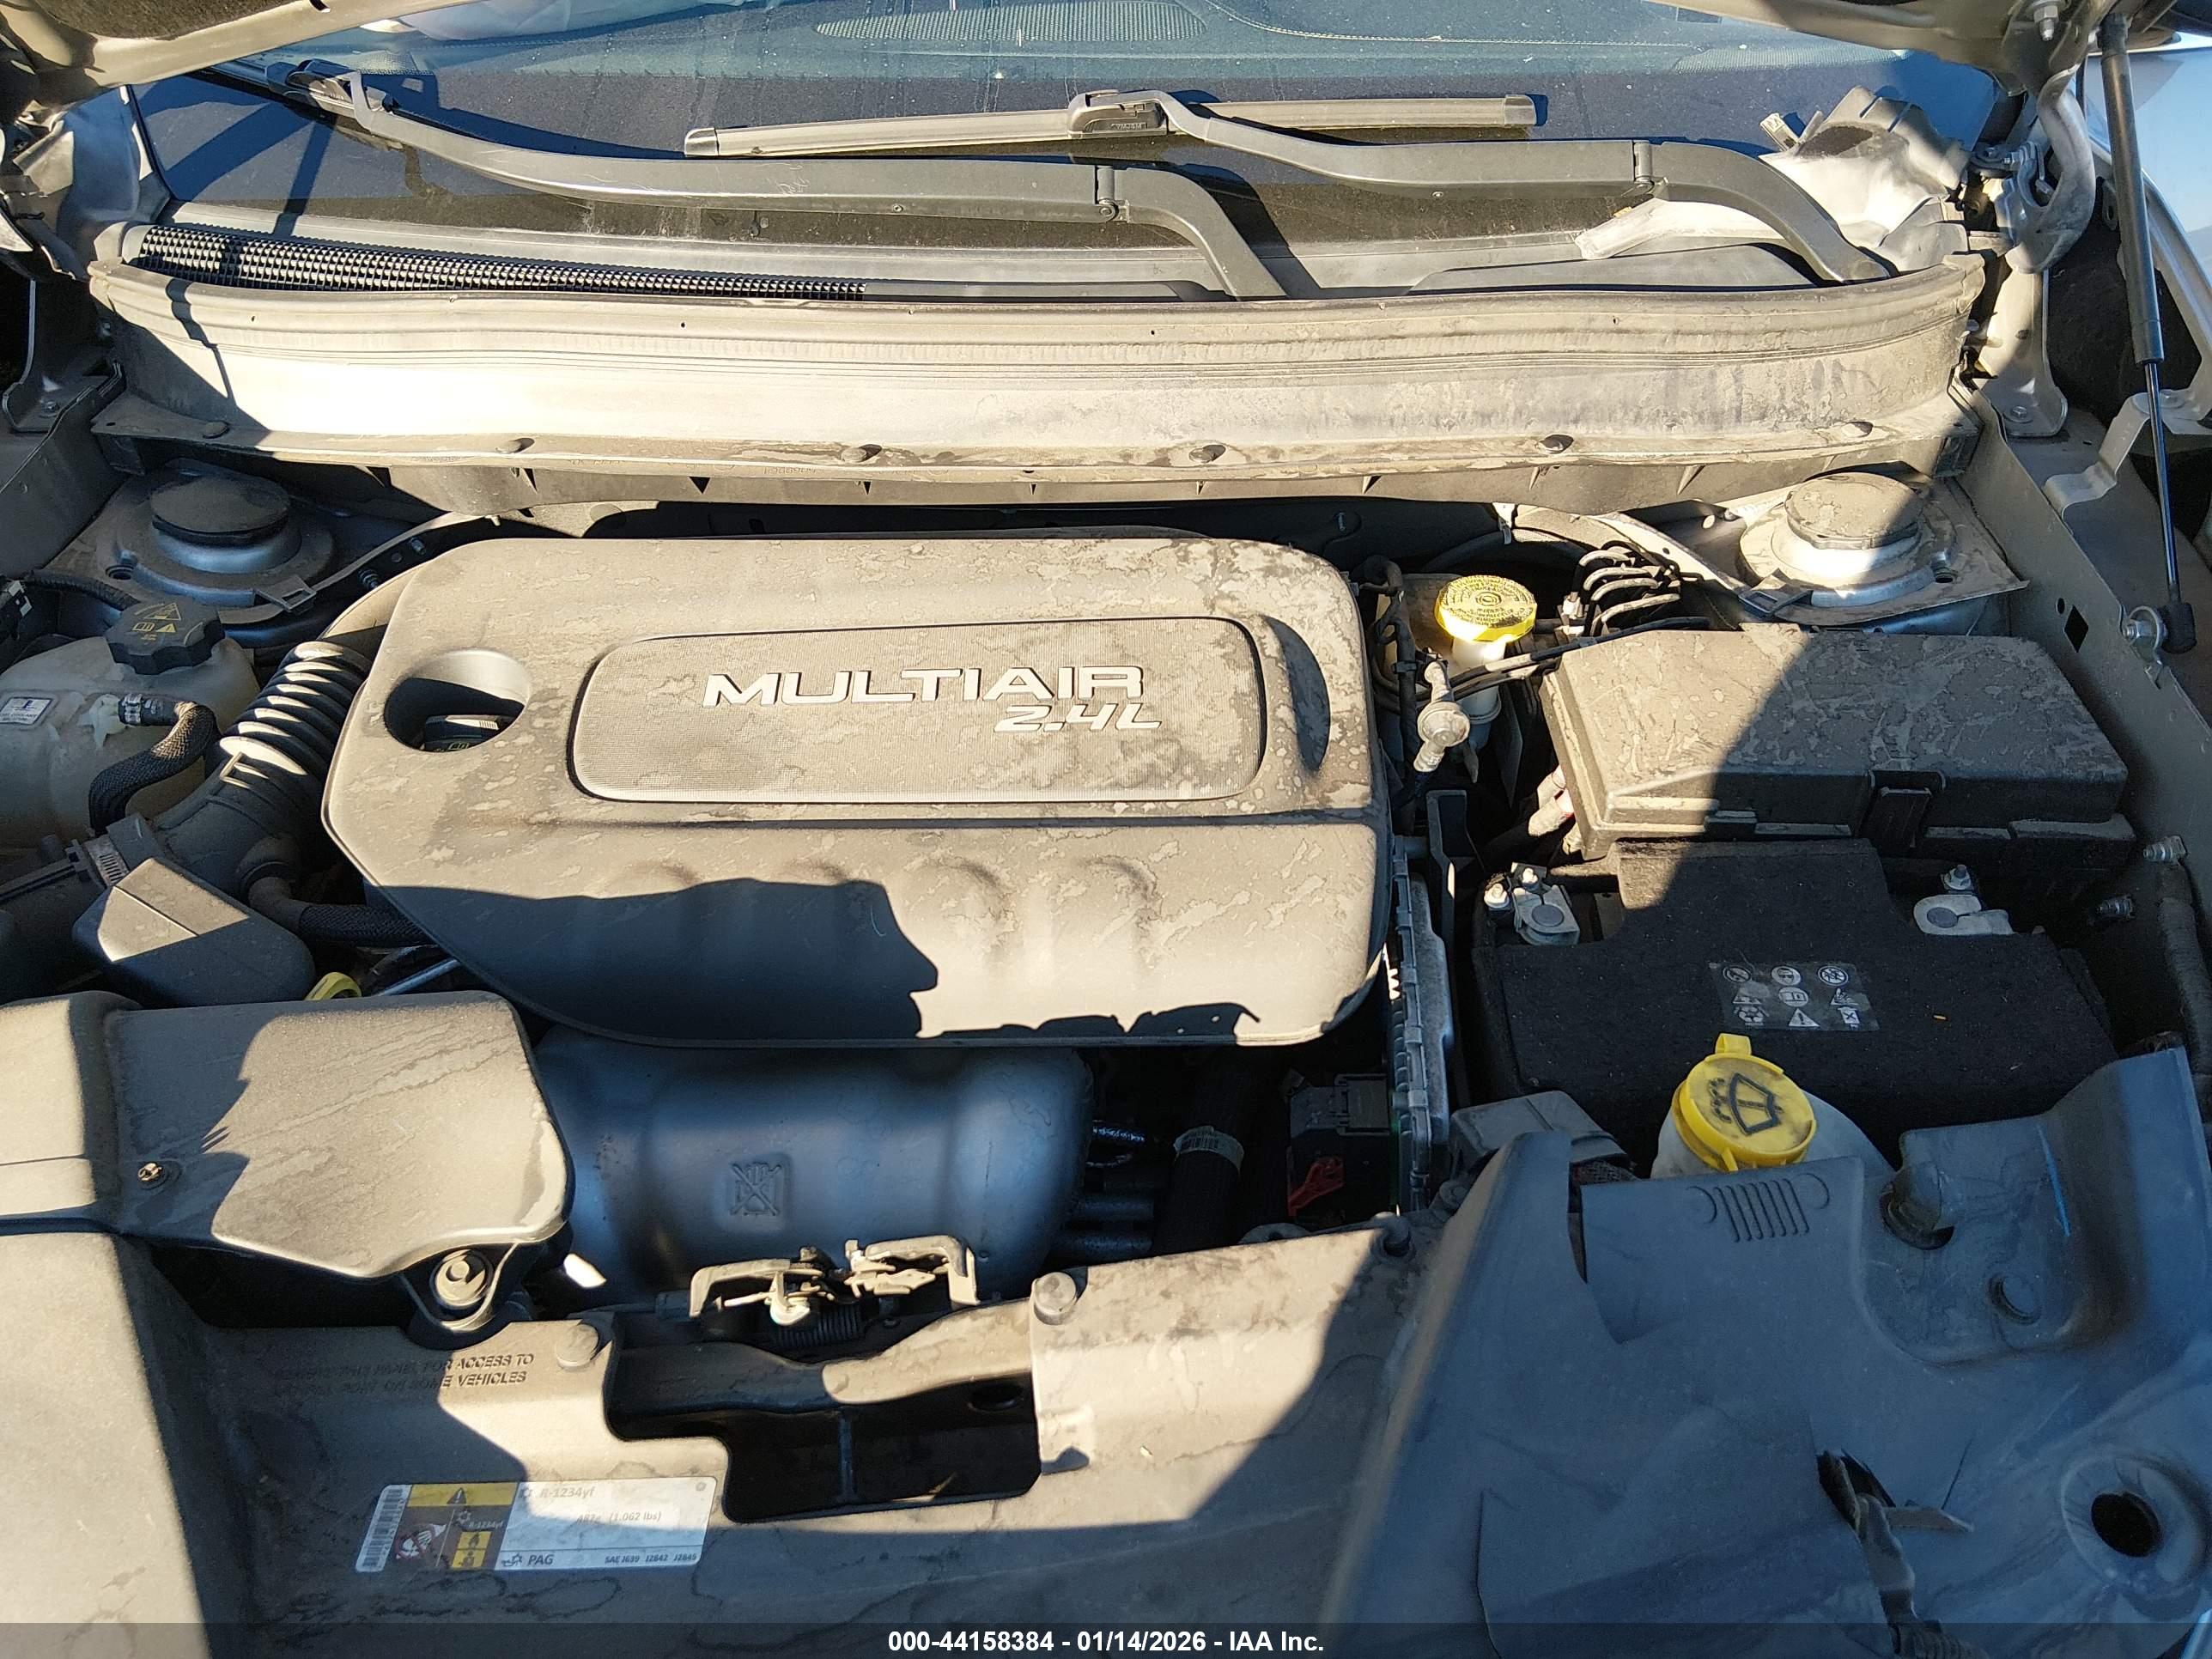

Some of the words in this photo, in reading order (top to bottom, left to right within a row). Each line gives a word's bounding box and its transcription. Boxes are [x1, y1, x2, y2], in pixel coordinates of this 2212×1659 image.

[702, 665, 1143, 708] MULTIAIR
[994, 702, 1162, 733] 2.4L
[455, 1354, 511, 1370] ACCESS
[515, 1353, 534, 1365] TO
[457, 1371, 527, 1387] VEHICLES
[539, 1486, 595, 1500] R-1234yf
[609, 1511, 640, 1523] (1.062
[643, 1511, 661, 1522] lbs)
[527, 1553, 555, 1565] PAG
[605, 1555, 620, 1564] SAE
